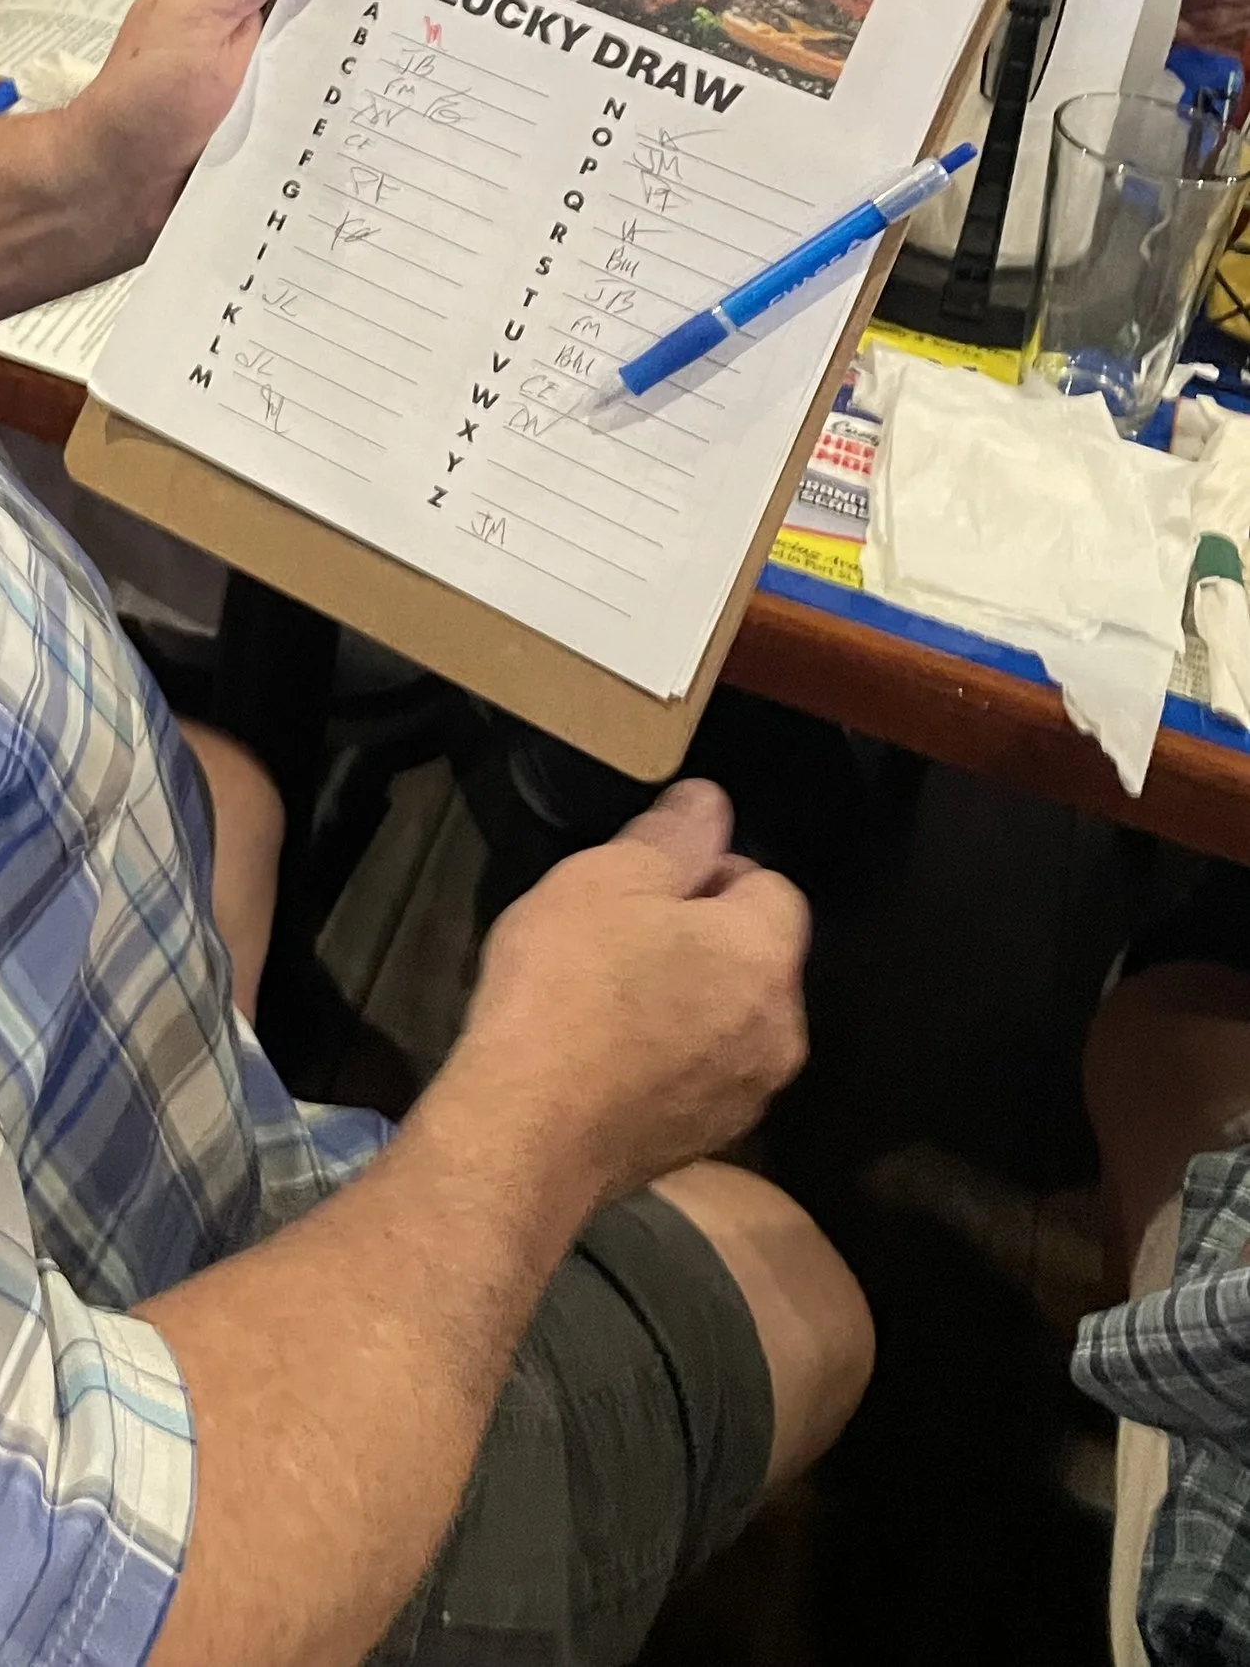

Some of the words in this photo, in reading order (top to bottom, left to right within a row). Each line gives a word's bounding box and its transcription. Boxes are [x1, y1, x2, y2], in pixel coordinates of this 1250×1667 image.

[363, 2, 379, 20] A
[352, 27, 368, 45] B
[341, 56, 357, 75] C
[591, 34, 745, 113] DRAW
[324, 86, 342, 104] D
[602, 97, 627, 120] N
[312, 118, 328, 136] E
[592, 127, 613, 147] O
[298, 149, 314, 166] F
[579, 156, 598, 175] P
[282, 180, 301, 199] G
[563, 190, 584, 213] Q
[267, 210, 288, 231] H
[549, 221, 568, 244] R
[257, 242, 268, 260] I
[535, 256, 553, 275] S
[239, 274, 254, 291] J
[523, 287, 538, 307] T
[222, 302, 242, 325] K
[504, 319, 525, 341] U
[209, 335, 221, 354] L
[493, 352, 511, 373] V
[188, 364, 212, 389] M
[472, 382, 500, 410] W
[457, 417, 480, 443] X
[447, 450, 465, 472] Y
[427, 485, 448, 509] Z
